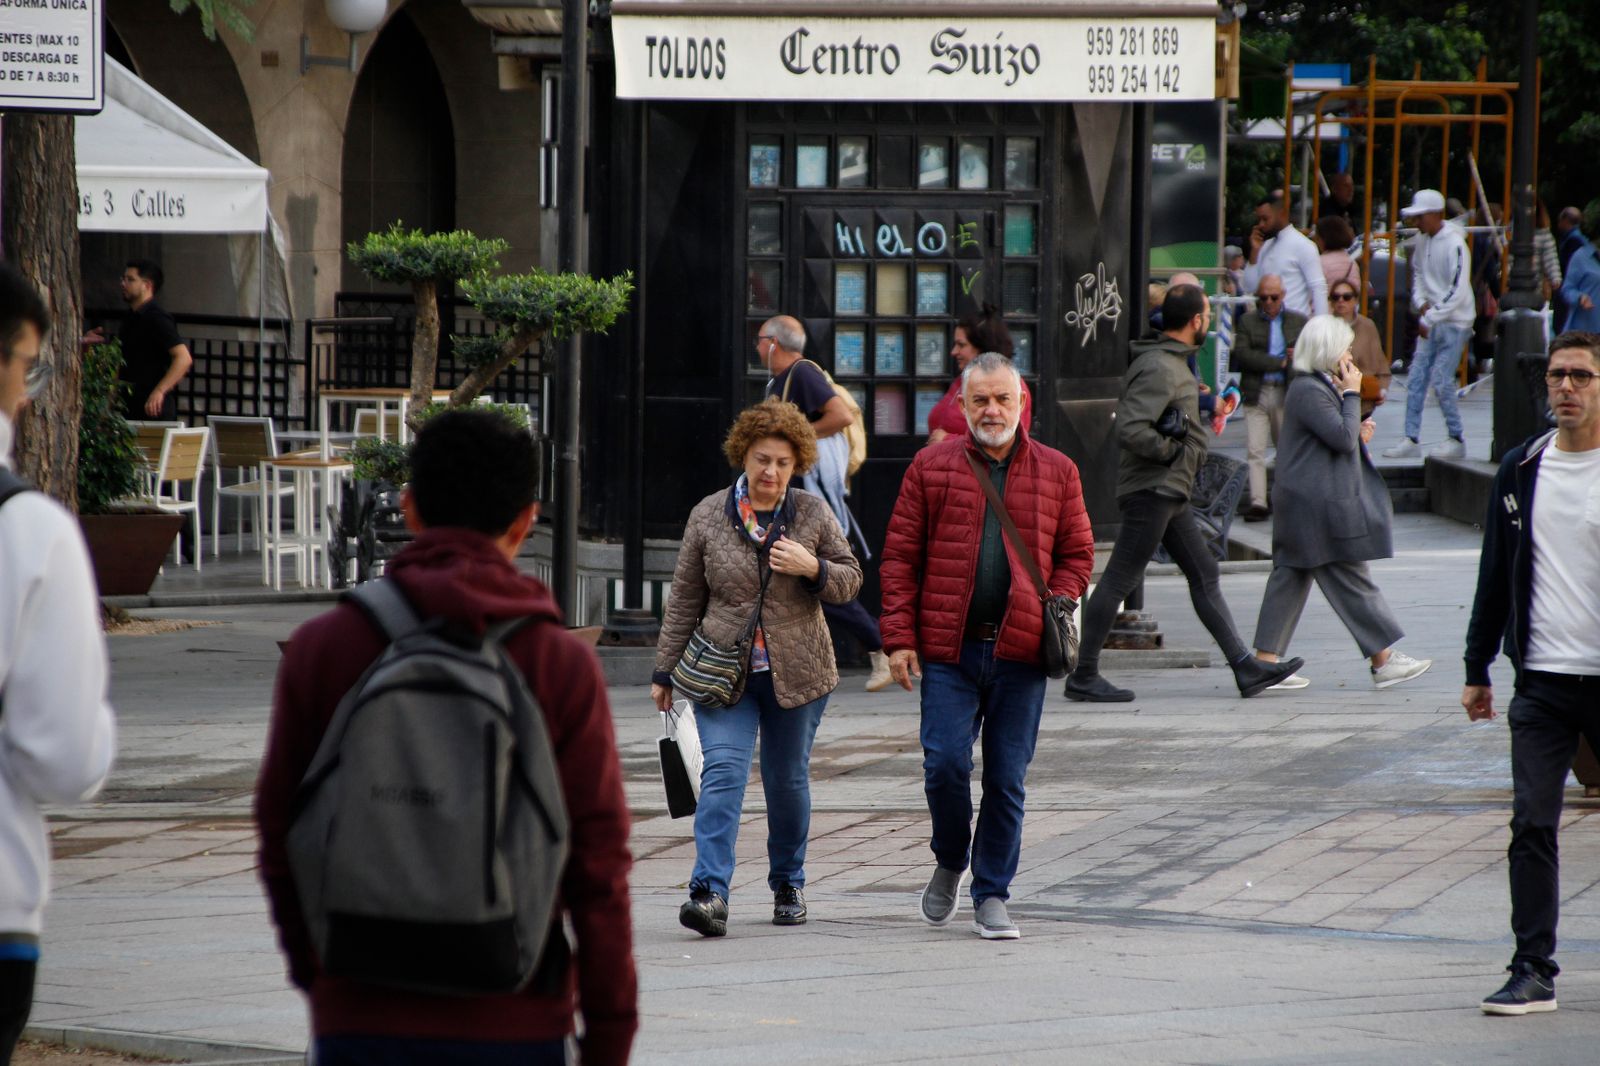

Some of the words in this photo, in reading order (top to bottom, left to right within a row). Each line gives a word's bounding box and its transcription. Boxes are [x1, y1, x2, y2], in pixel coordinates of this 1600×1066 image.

[36, 34, 63, 47] (MAX
[67, 35, 80, 46] 10
[779, 26, 901, 75] Centro
[1087, 26, 1113, 56] 959
[1119, 26, 1145, 56] 281
[1152, 26, 1179, 56] 869
[2, 51, 61, 64] DESCARGA
[64, 54, 79, 65] DE
[645, 35, 727, 80] TOLDOS
[9, 70, 24, 81] DE
[27, 70, 34, 81] 7
[37, 71, 45, 82] A
[47, 71, 70, 83] 8:30
[72, 72, 80, 83] h
[1088, 64, 1115, 93] 959
[1121, 64, 1148, 93] 254
[1154, 64, 1180, 93] 142
[103, 188, 114, 216] 3
[131, 188, 186, 217] Calles
